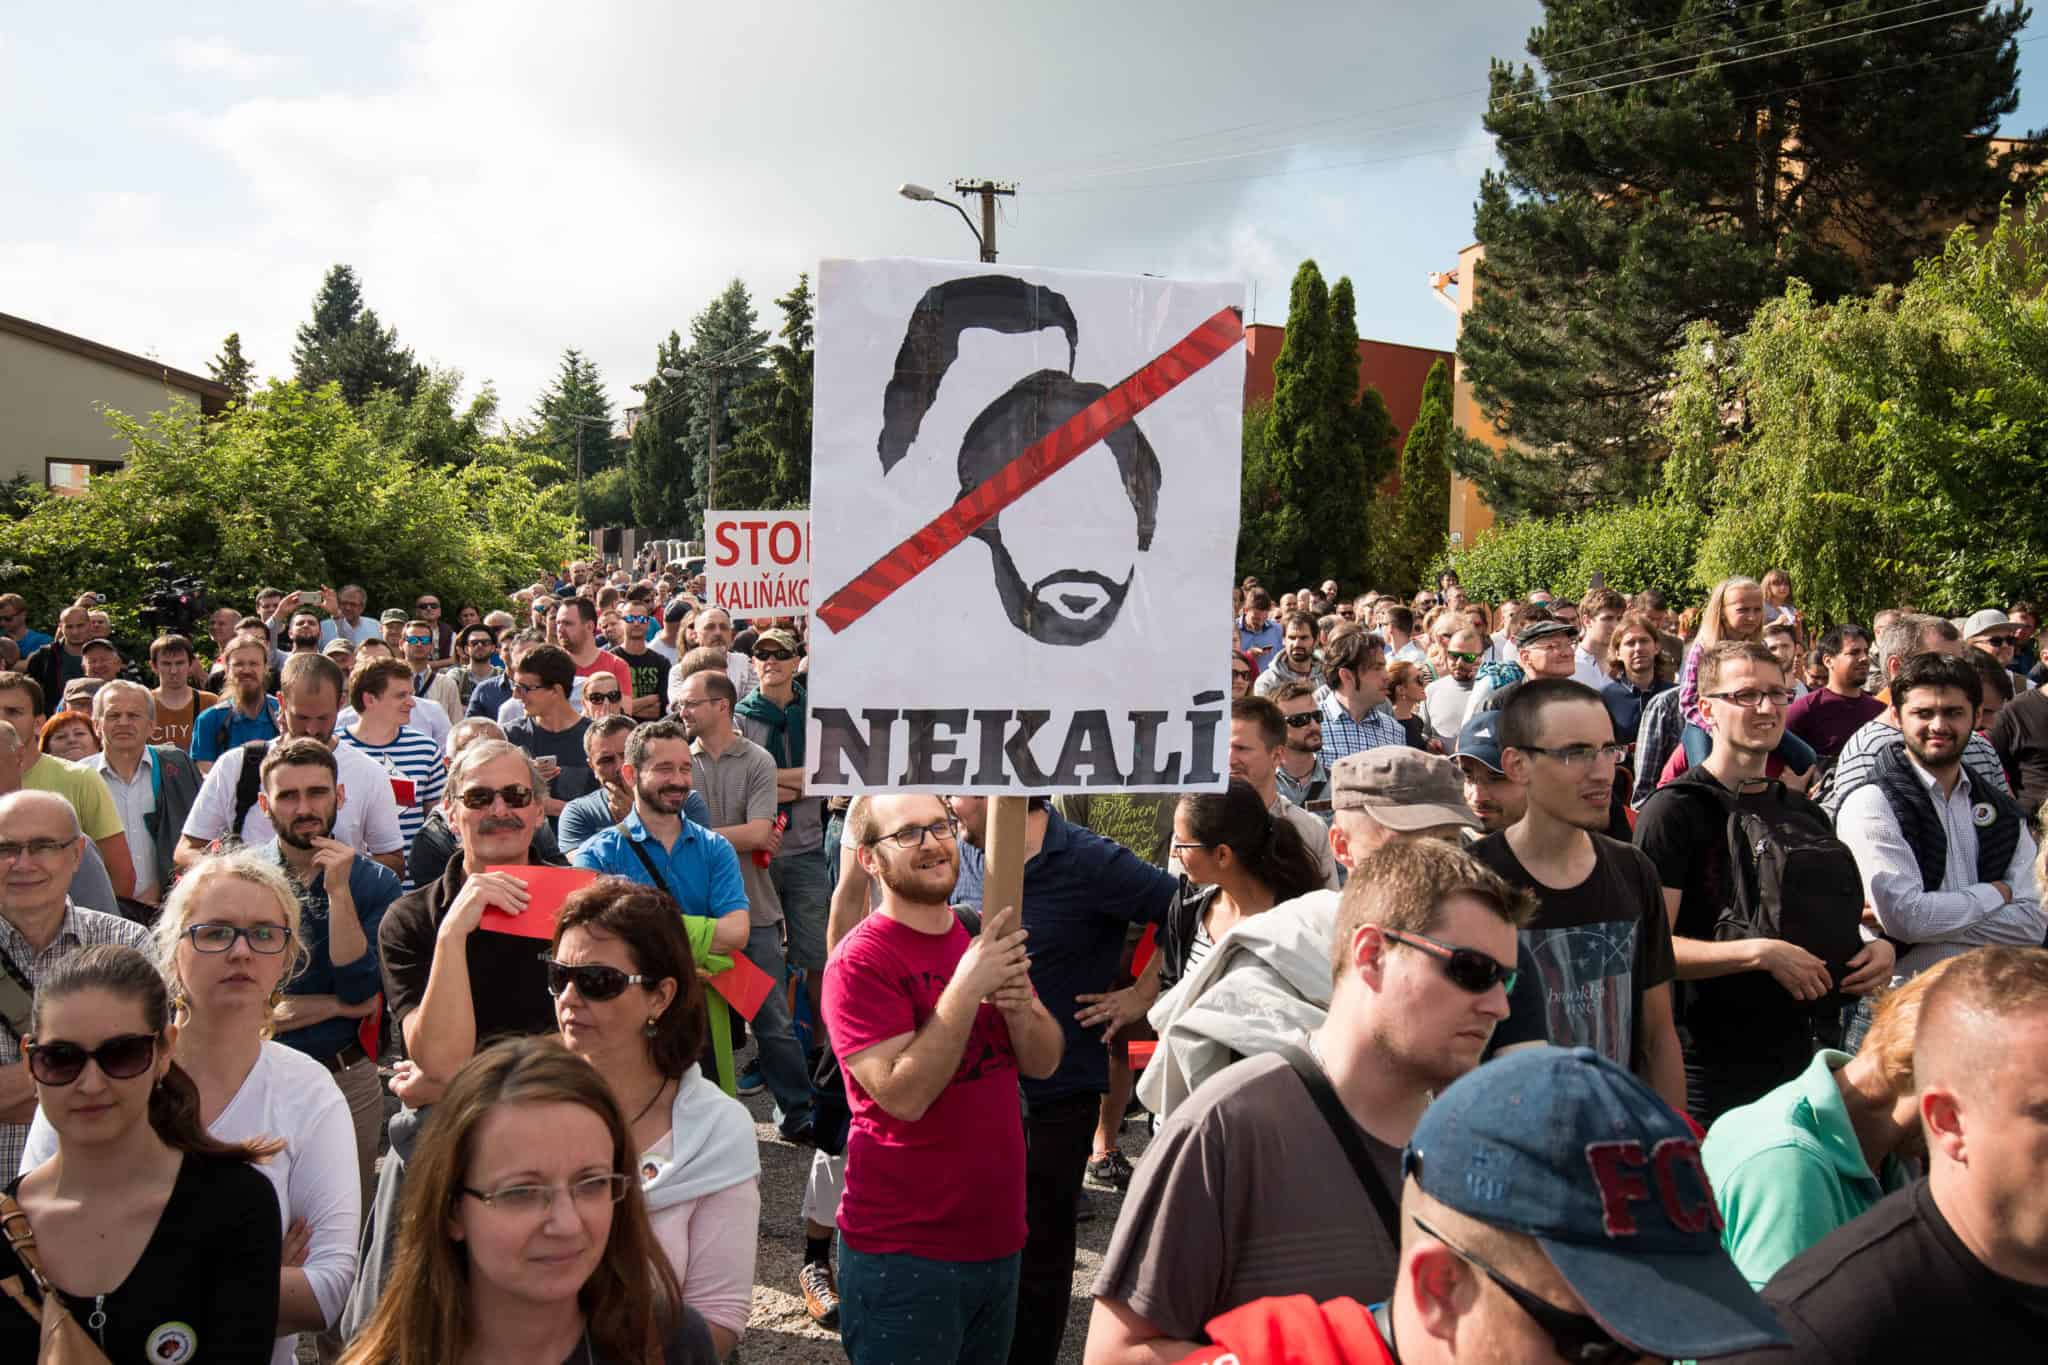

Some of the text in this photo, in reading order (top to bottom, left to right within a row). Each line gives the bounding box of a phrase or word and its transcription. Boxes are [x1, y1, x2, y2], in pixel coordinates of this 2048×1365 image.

[715, 520, 810, 567] STO
[151, 724, 190, 741] CITY
[811, 690, 1224, 786] NEKALÍ
